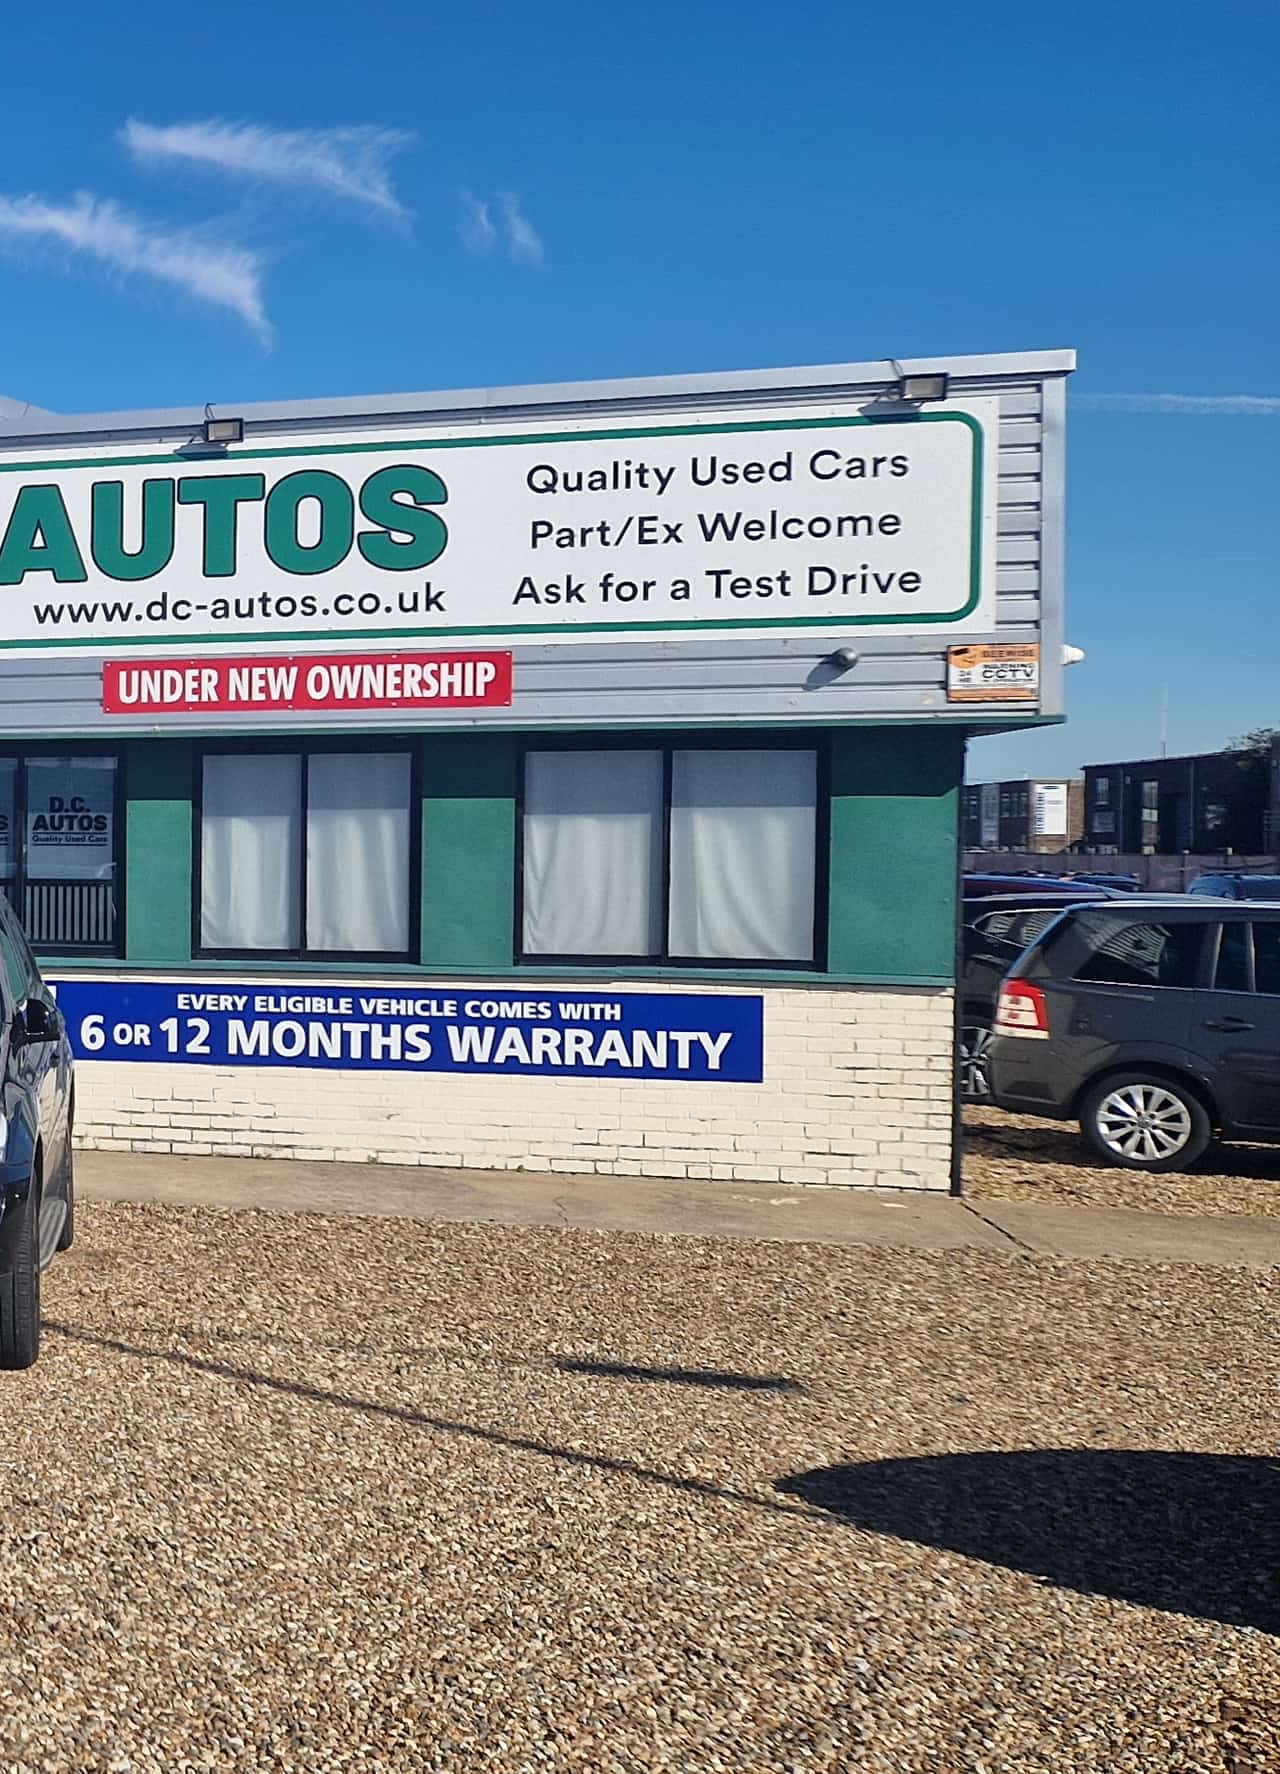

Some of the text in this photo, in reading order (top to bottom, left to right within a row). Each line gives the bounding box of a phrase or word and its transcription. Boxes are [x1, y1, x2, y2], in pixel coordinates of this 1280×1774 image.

[526, 448, 910, 496] Quality Used Cars
[531, 509, 901, 549] Part/Ex Welcome
[33, 583, 446, 625] www.dc-autos.co.uk
[512, 564, 921, 605] Ask for a Test Drive
[118, 661, 495, 705] UNDER NEW OWNERSHIP
[982, 669, 1034, 679] CCTV
[32, 814, 107, 831] AUTOS
[49, 796, 90, 813] D.C.
[32, 833, 107, 844] Quality Used Cars
[177, 994, 621, 1021] EVERY ELIGIBLE VEHICLE COMES WITH
[80, 1015, 733, 1070] 6 OR 12 MONTHS WARRANTY
